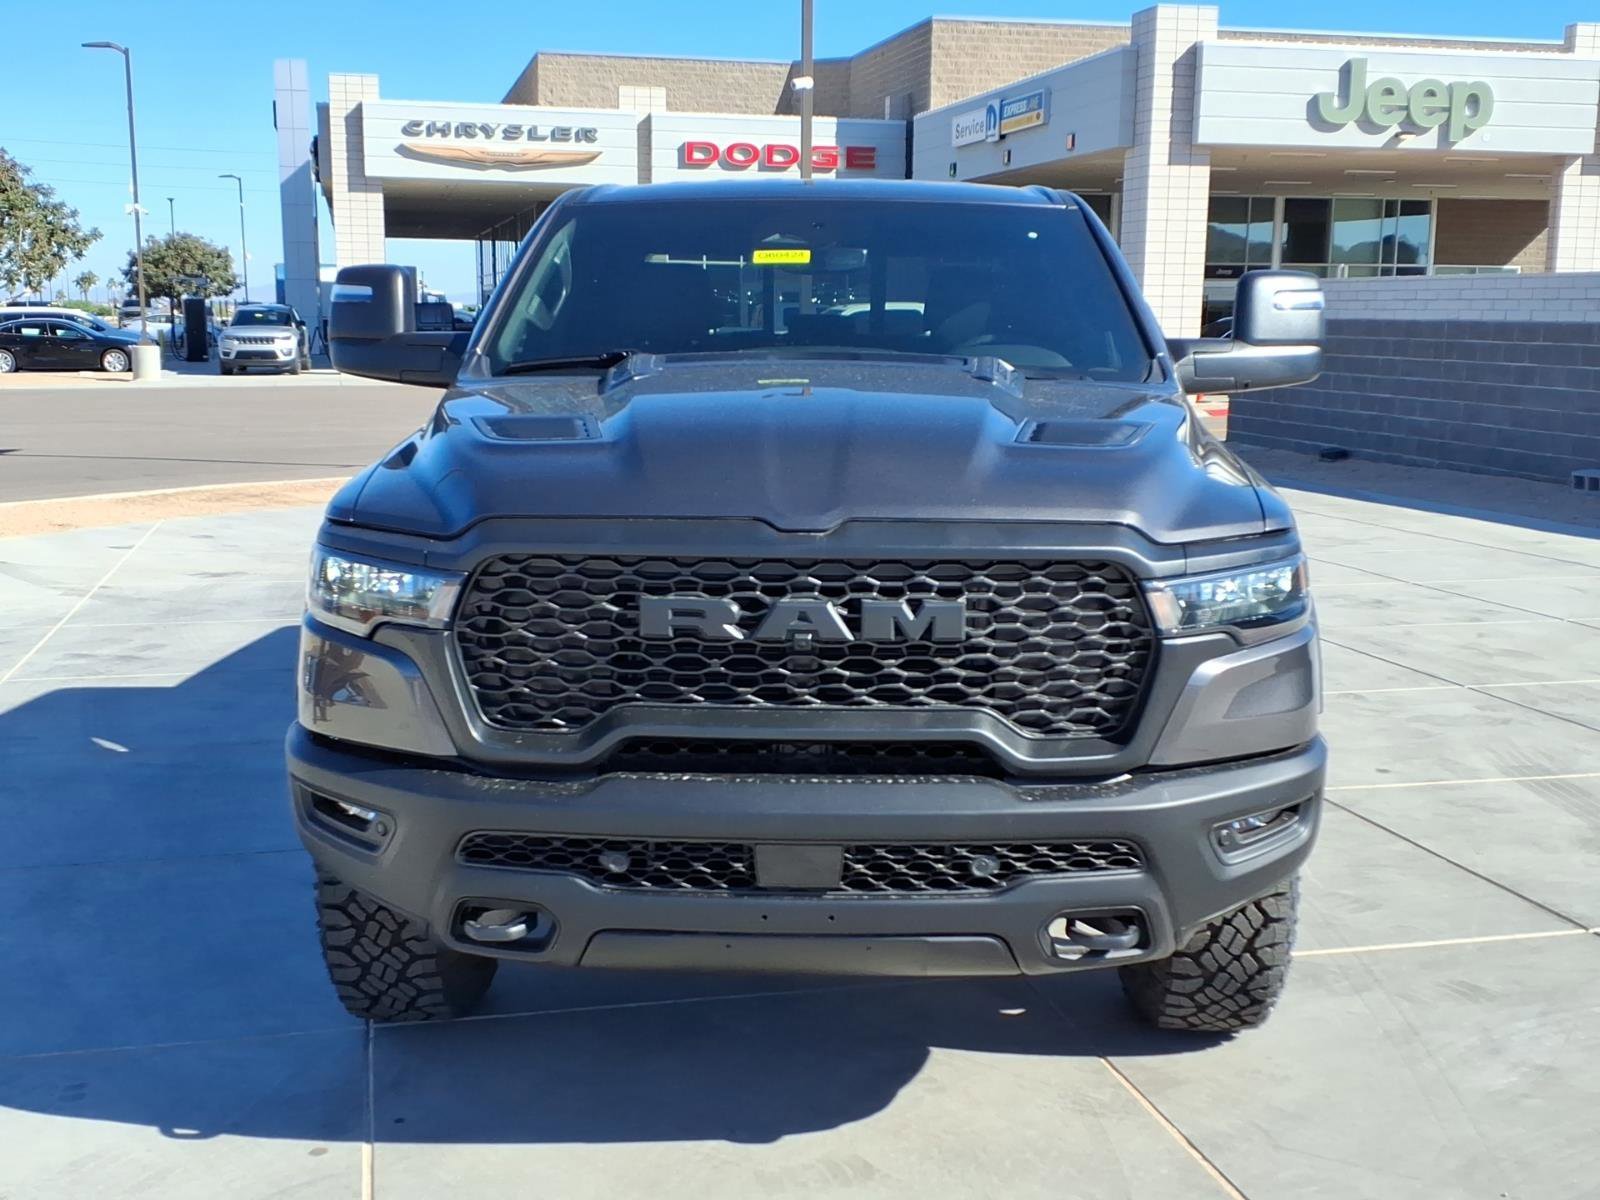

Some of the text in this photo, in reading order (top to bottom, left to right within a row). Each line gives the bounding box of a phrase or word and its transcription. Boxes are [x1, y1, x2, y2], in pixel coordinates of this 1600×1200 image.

[1003, 99, 1027, 118] EXPRESS
[1319, 58, 1494, 142] Jeep
[401, 120, 599, 143] CHRYSLER
[955, 119, 985, 139] Service
[684, 141, 876, 169] DODGE
[639, 598, 967, 641] RAM
